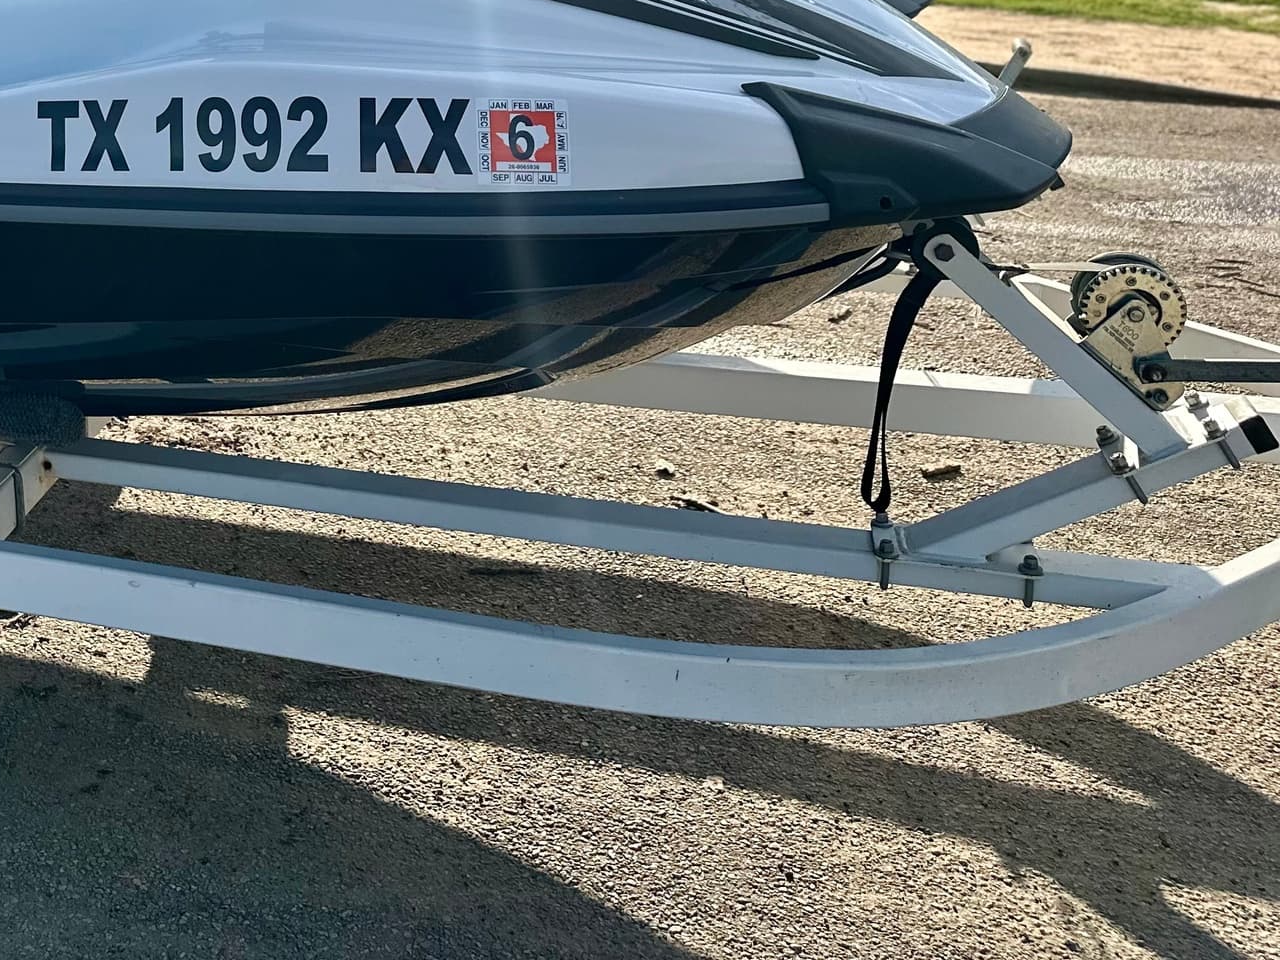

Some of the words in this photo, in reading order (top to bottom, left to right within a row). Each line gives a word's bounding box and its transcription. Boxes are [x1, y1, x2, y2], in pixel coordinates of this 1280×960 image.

[490, 101, 507, 109] JAN
[513, 102, 530, 110] FEB
[536, 102, 553, 110] MAR
[480, 111, 488, 127] DEC
[36, 98, 131, 172] TX
[155, 96, 329, 173] 1992
[358, 96, 474, 175] KX
[481, 132, 489, 149] NOV
[508, 114, 535, 161] 6
[557, 134, 565, 151] MAY
[481, 154, 490, 171] OCT
[558, 156, 566, 172] JUN
[492, 173, 509, 181] SEP
[516, 174, 533, 182] AUG
[539, 175, 556, 183] JUL
[1118, 320, 1140, 341] T600
